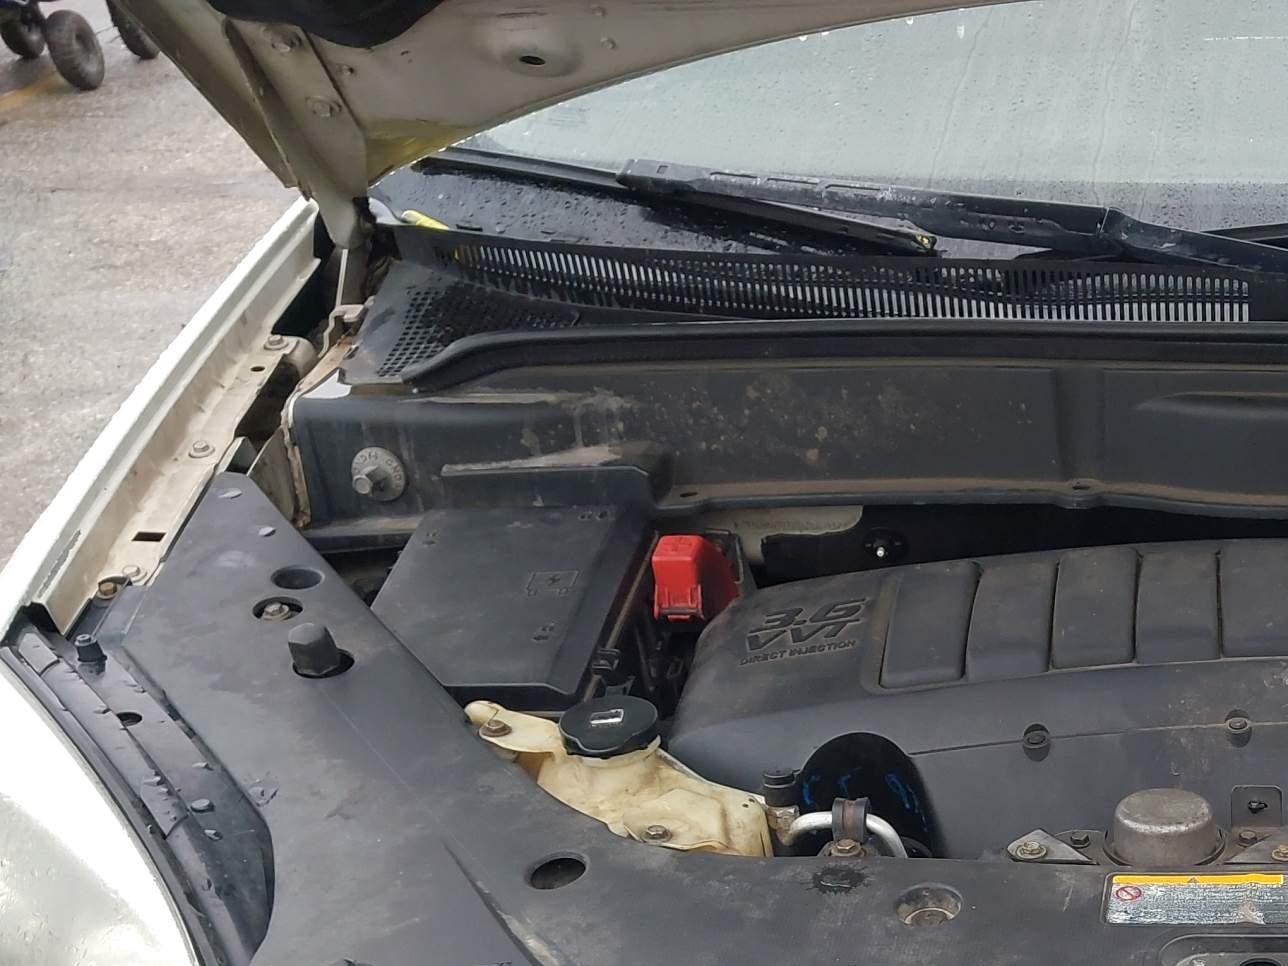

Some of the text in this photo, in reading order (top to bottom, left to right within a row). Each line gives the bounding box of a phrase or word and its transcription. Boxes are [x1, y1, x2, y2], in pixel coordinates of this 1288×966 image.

[763, 598, 868, 627] 3.6
[747, 618, 861, 651] VVT
[739, 640, 856, 666] DIRECT INJECTION
